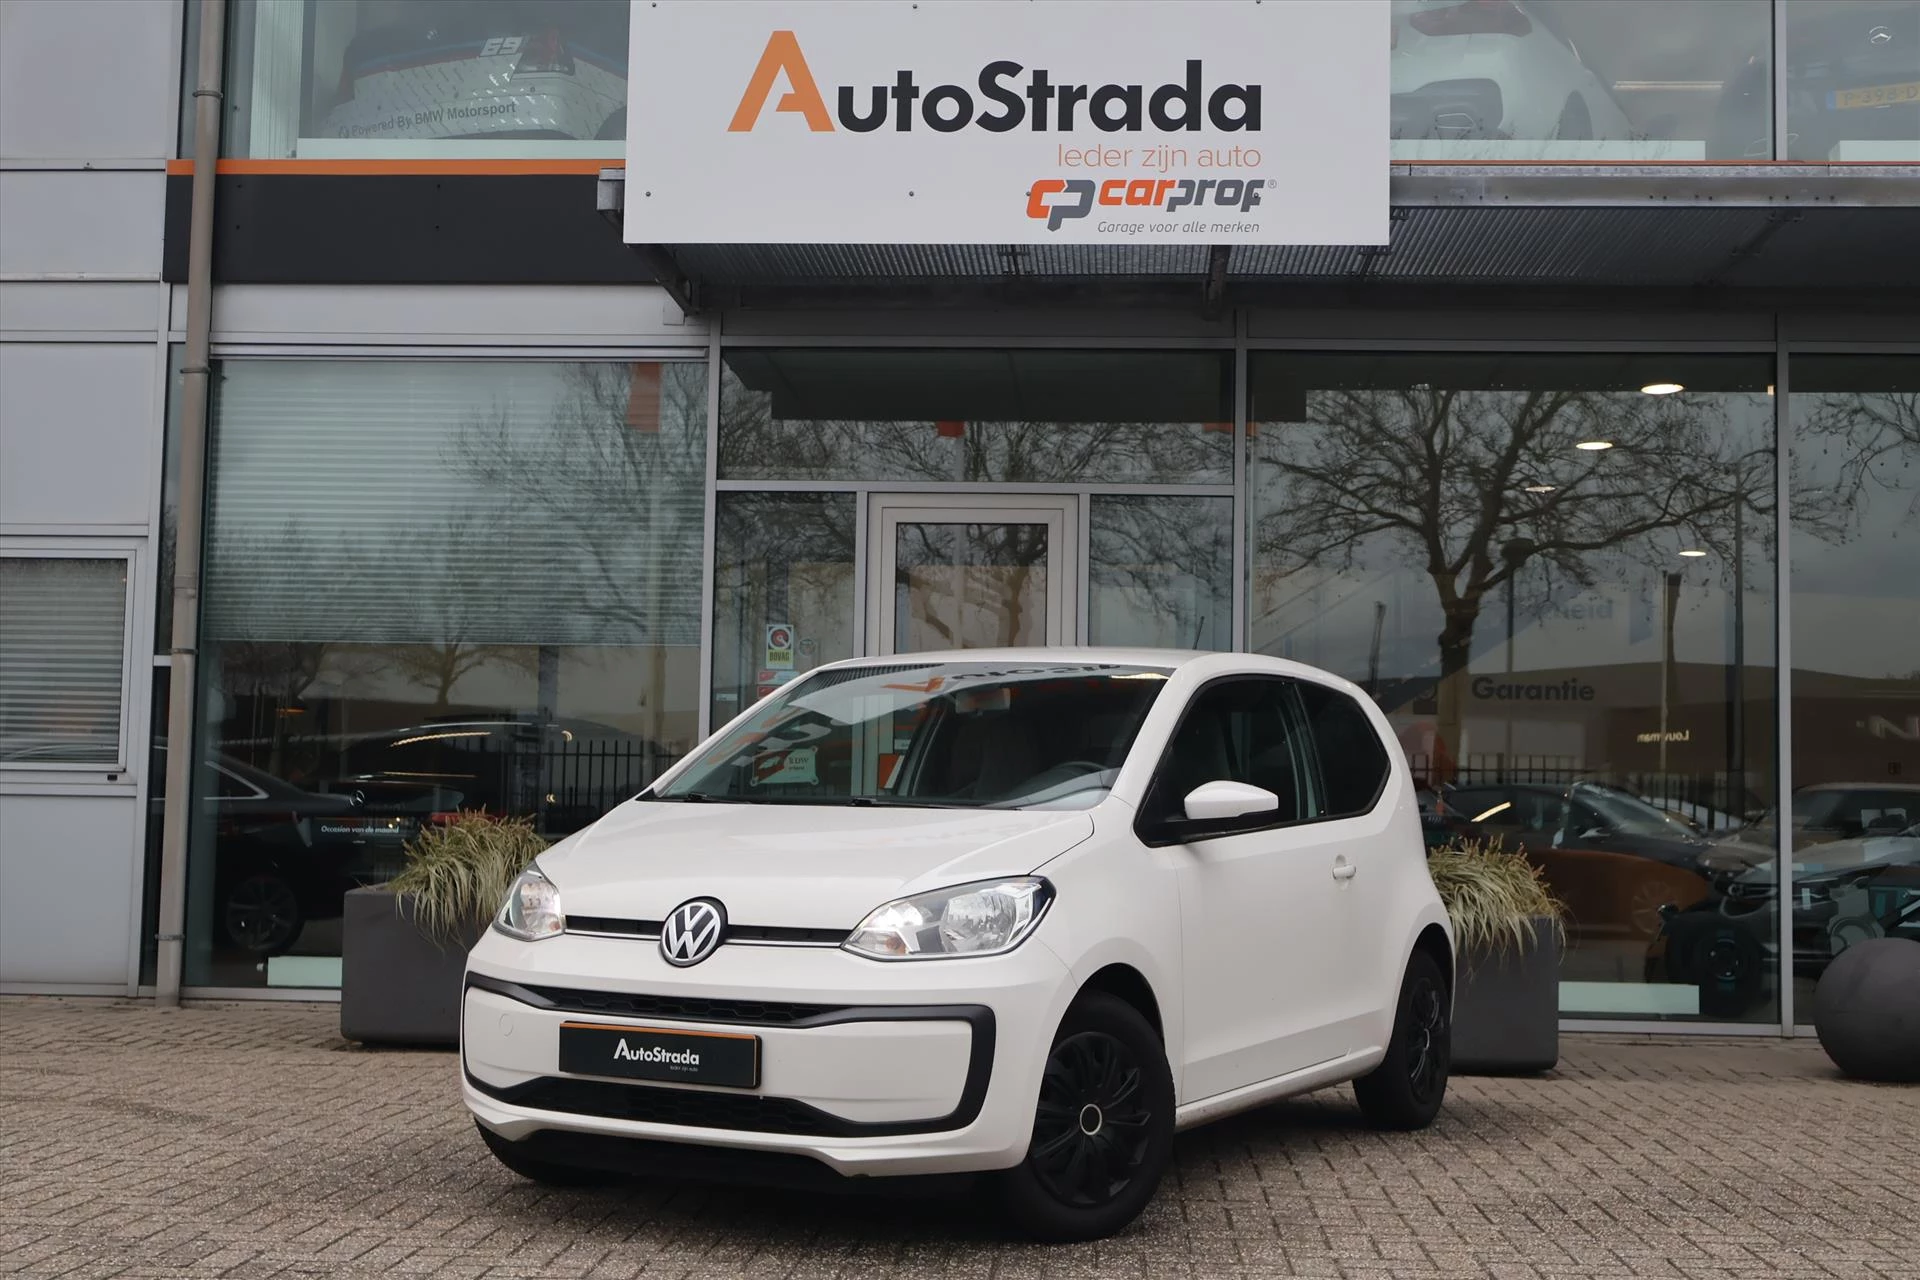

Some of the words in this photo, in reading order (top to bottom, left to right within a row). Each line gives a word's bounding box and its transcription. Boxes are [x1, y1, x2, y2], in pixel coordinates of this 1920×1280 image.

[727, 30, 1262, 133] AutoStrada
[351, 117, 394, 137] Powered
[397, 115, 412, 131] By
[415, 110, 444, 125] BMW
[447, 102, 517, 121] Motorsport
[1058, 143, 1133, 168] Ieder
[1142, 144, 1188, 173] zijn
[1197, 145, 1262, 168] auto
[1097, 220, 1145, 236] Garage
[1149, 223, 1179, 233] voor
[1182, 220, 1207, 233] alle
[1210, 220, 1260, 233] merken
[769, 651, 790, 662] BOVAG
[1471, 676, 1596, 701] Garantie
[321, 824, 351, 833] Occasion
[365, 825, 374, 833] de
[375, 825, 400, 834] maand
[613, 1038, 700, 1065] AutoStrada
